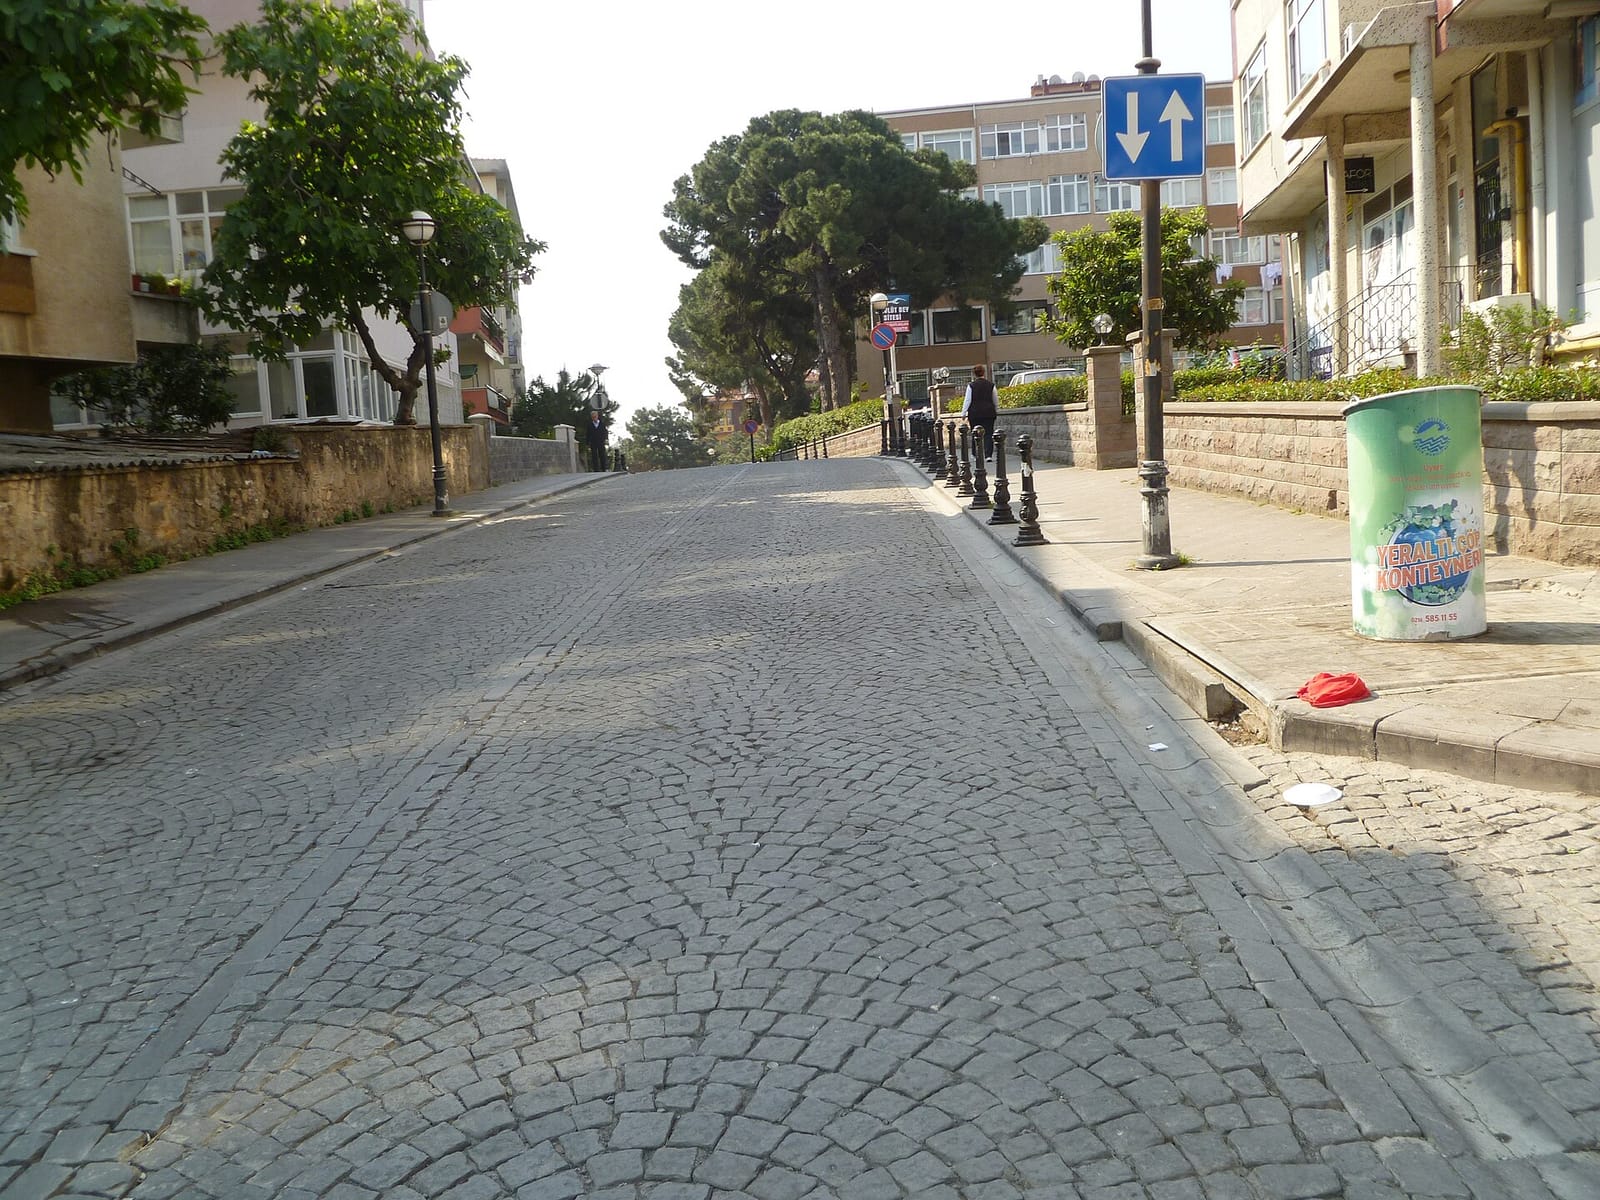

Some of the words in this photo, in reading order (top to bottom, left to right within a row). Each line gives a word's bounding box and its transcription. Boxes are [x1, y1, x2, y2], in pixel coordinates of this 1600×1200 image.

[1376, 536, 1453, 567] YERALTI
[1425, 613, 1440, 623] 585
[1441, 613, 1447, 622] 11
[1448, 612, 1458, 621] 55
